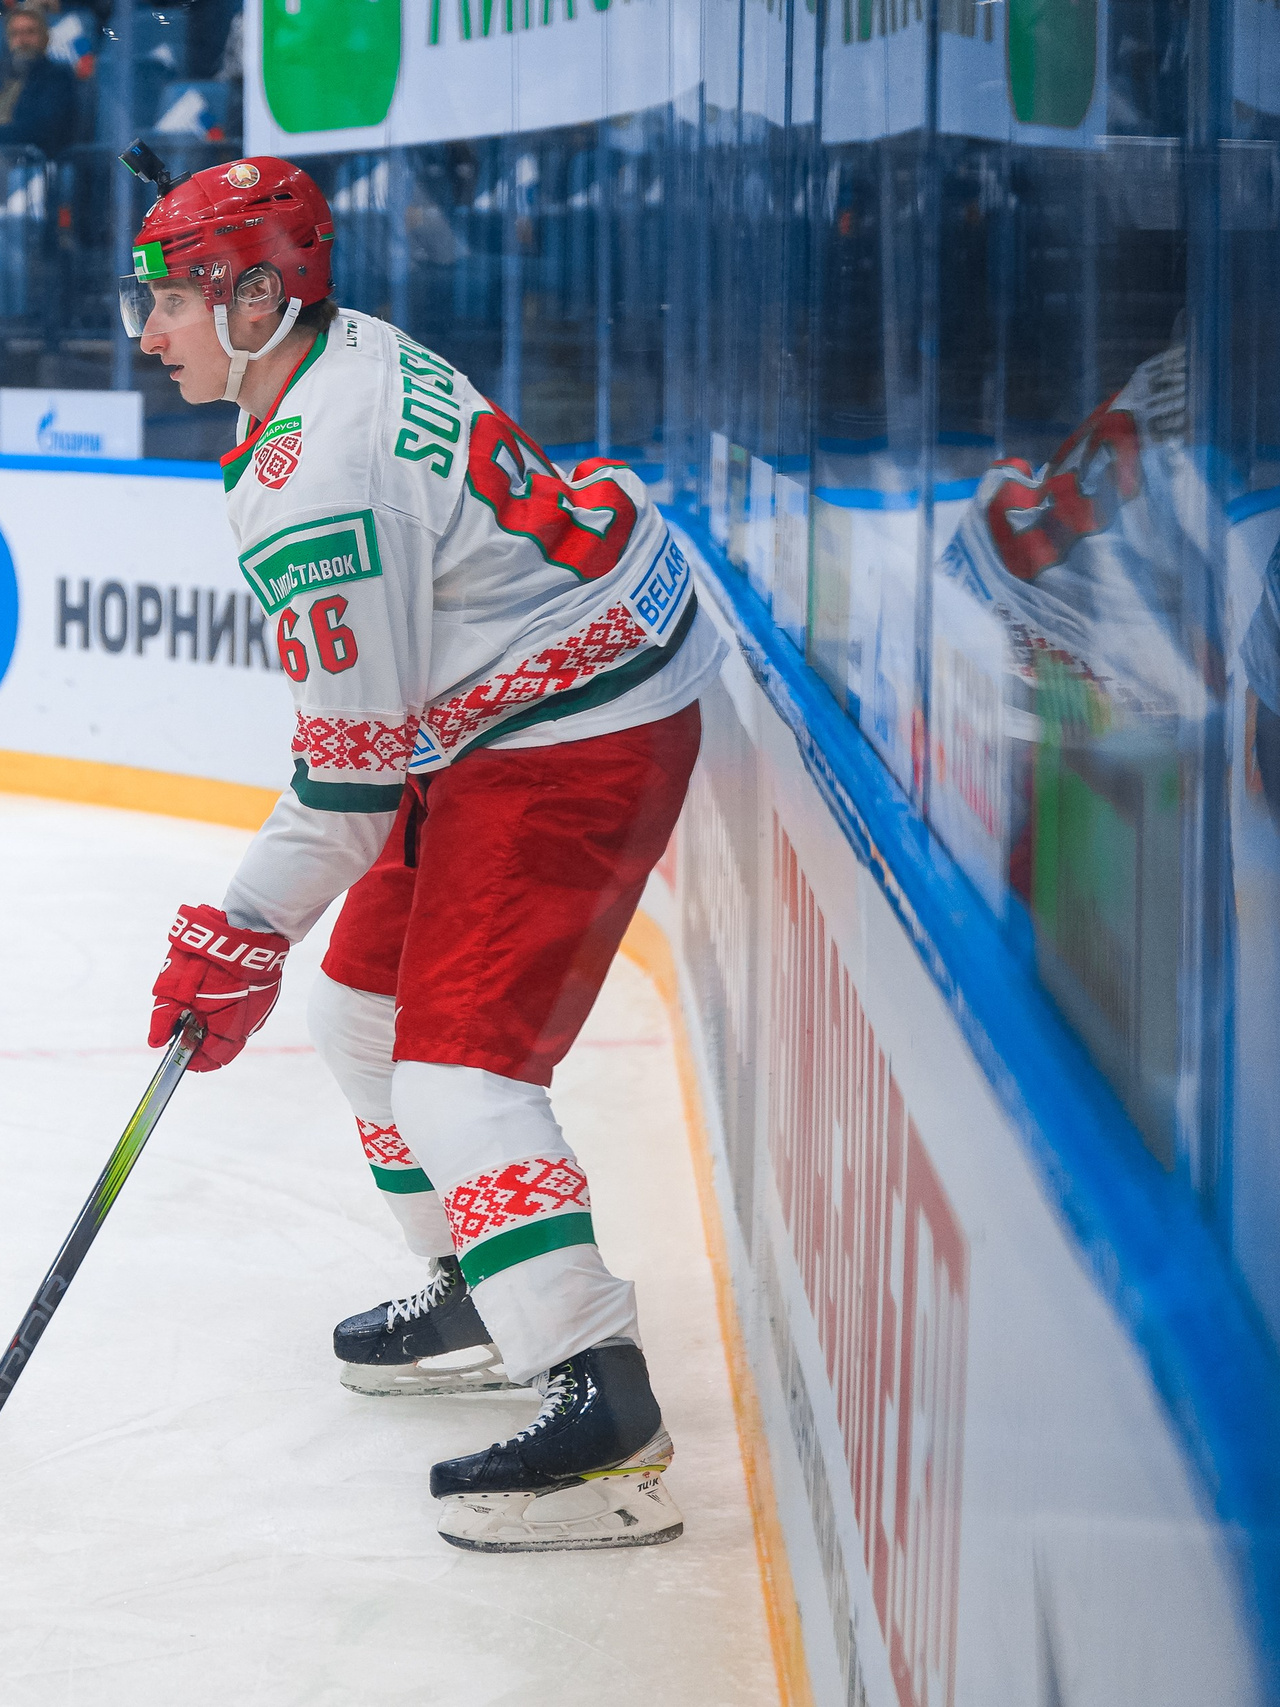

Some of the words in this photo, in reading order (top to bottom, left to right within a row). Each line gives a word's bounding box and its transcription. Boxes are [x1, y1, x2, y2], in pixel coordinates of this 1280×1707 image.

[214, 216, 264, 236] BAER
[277, 594, 358, 682] 66
[169, 914, 288, 972] BAUER
